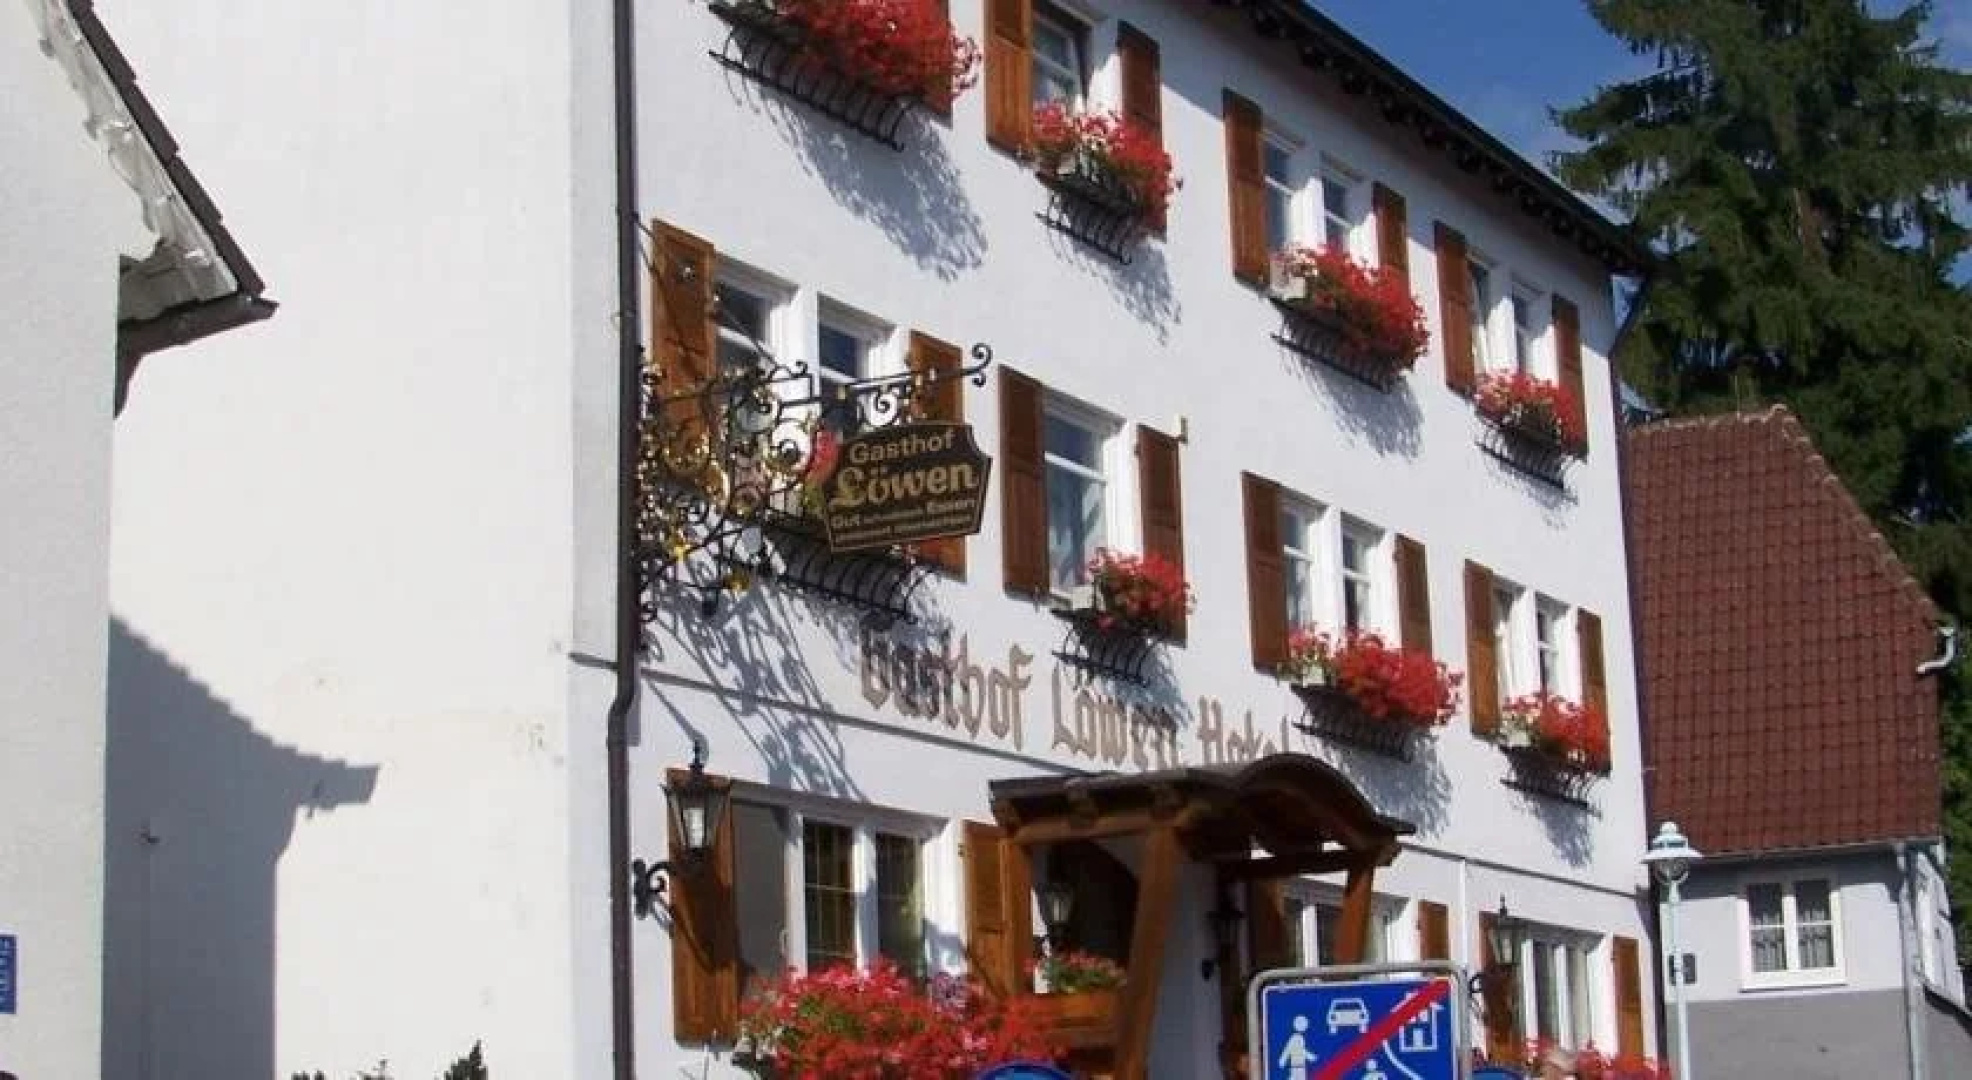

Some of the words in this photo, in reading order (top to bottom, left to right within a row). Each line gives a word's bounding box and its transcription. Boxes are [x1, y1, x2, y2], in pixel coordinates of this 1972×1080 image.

[850, 428, 955, 464] Gasthof
[830, 463, 979, 507] Löwen
[861, 630, 1034, 751] Gasthof
